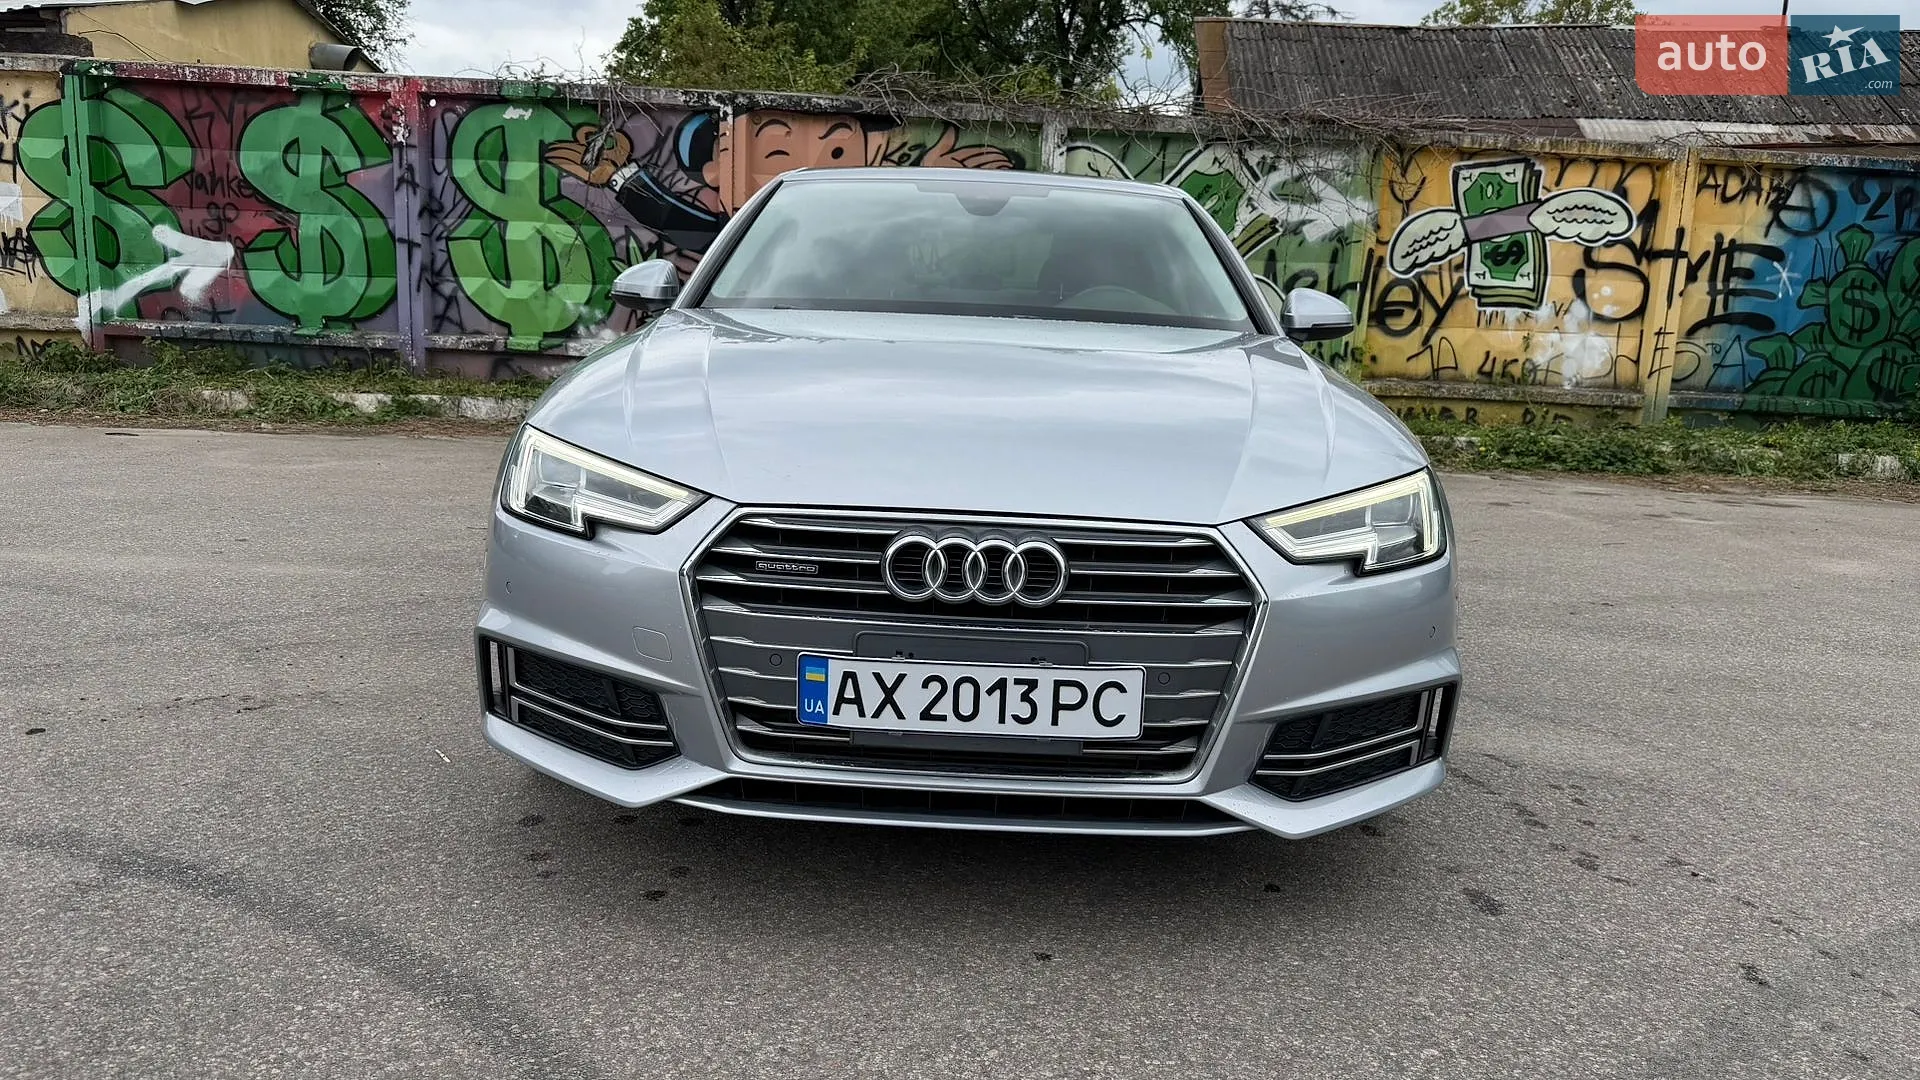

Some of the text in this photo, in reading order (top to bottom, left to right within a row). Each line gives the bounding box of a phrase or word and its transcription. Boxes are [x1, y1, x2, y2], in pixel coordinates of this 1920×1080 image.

[757, 562, 816, 572] quattro
[804, 698, 826, 715] UA
[832, 671, 1129, 729] AX 2013 PC
